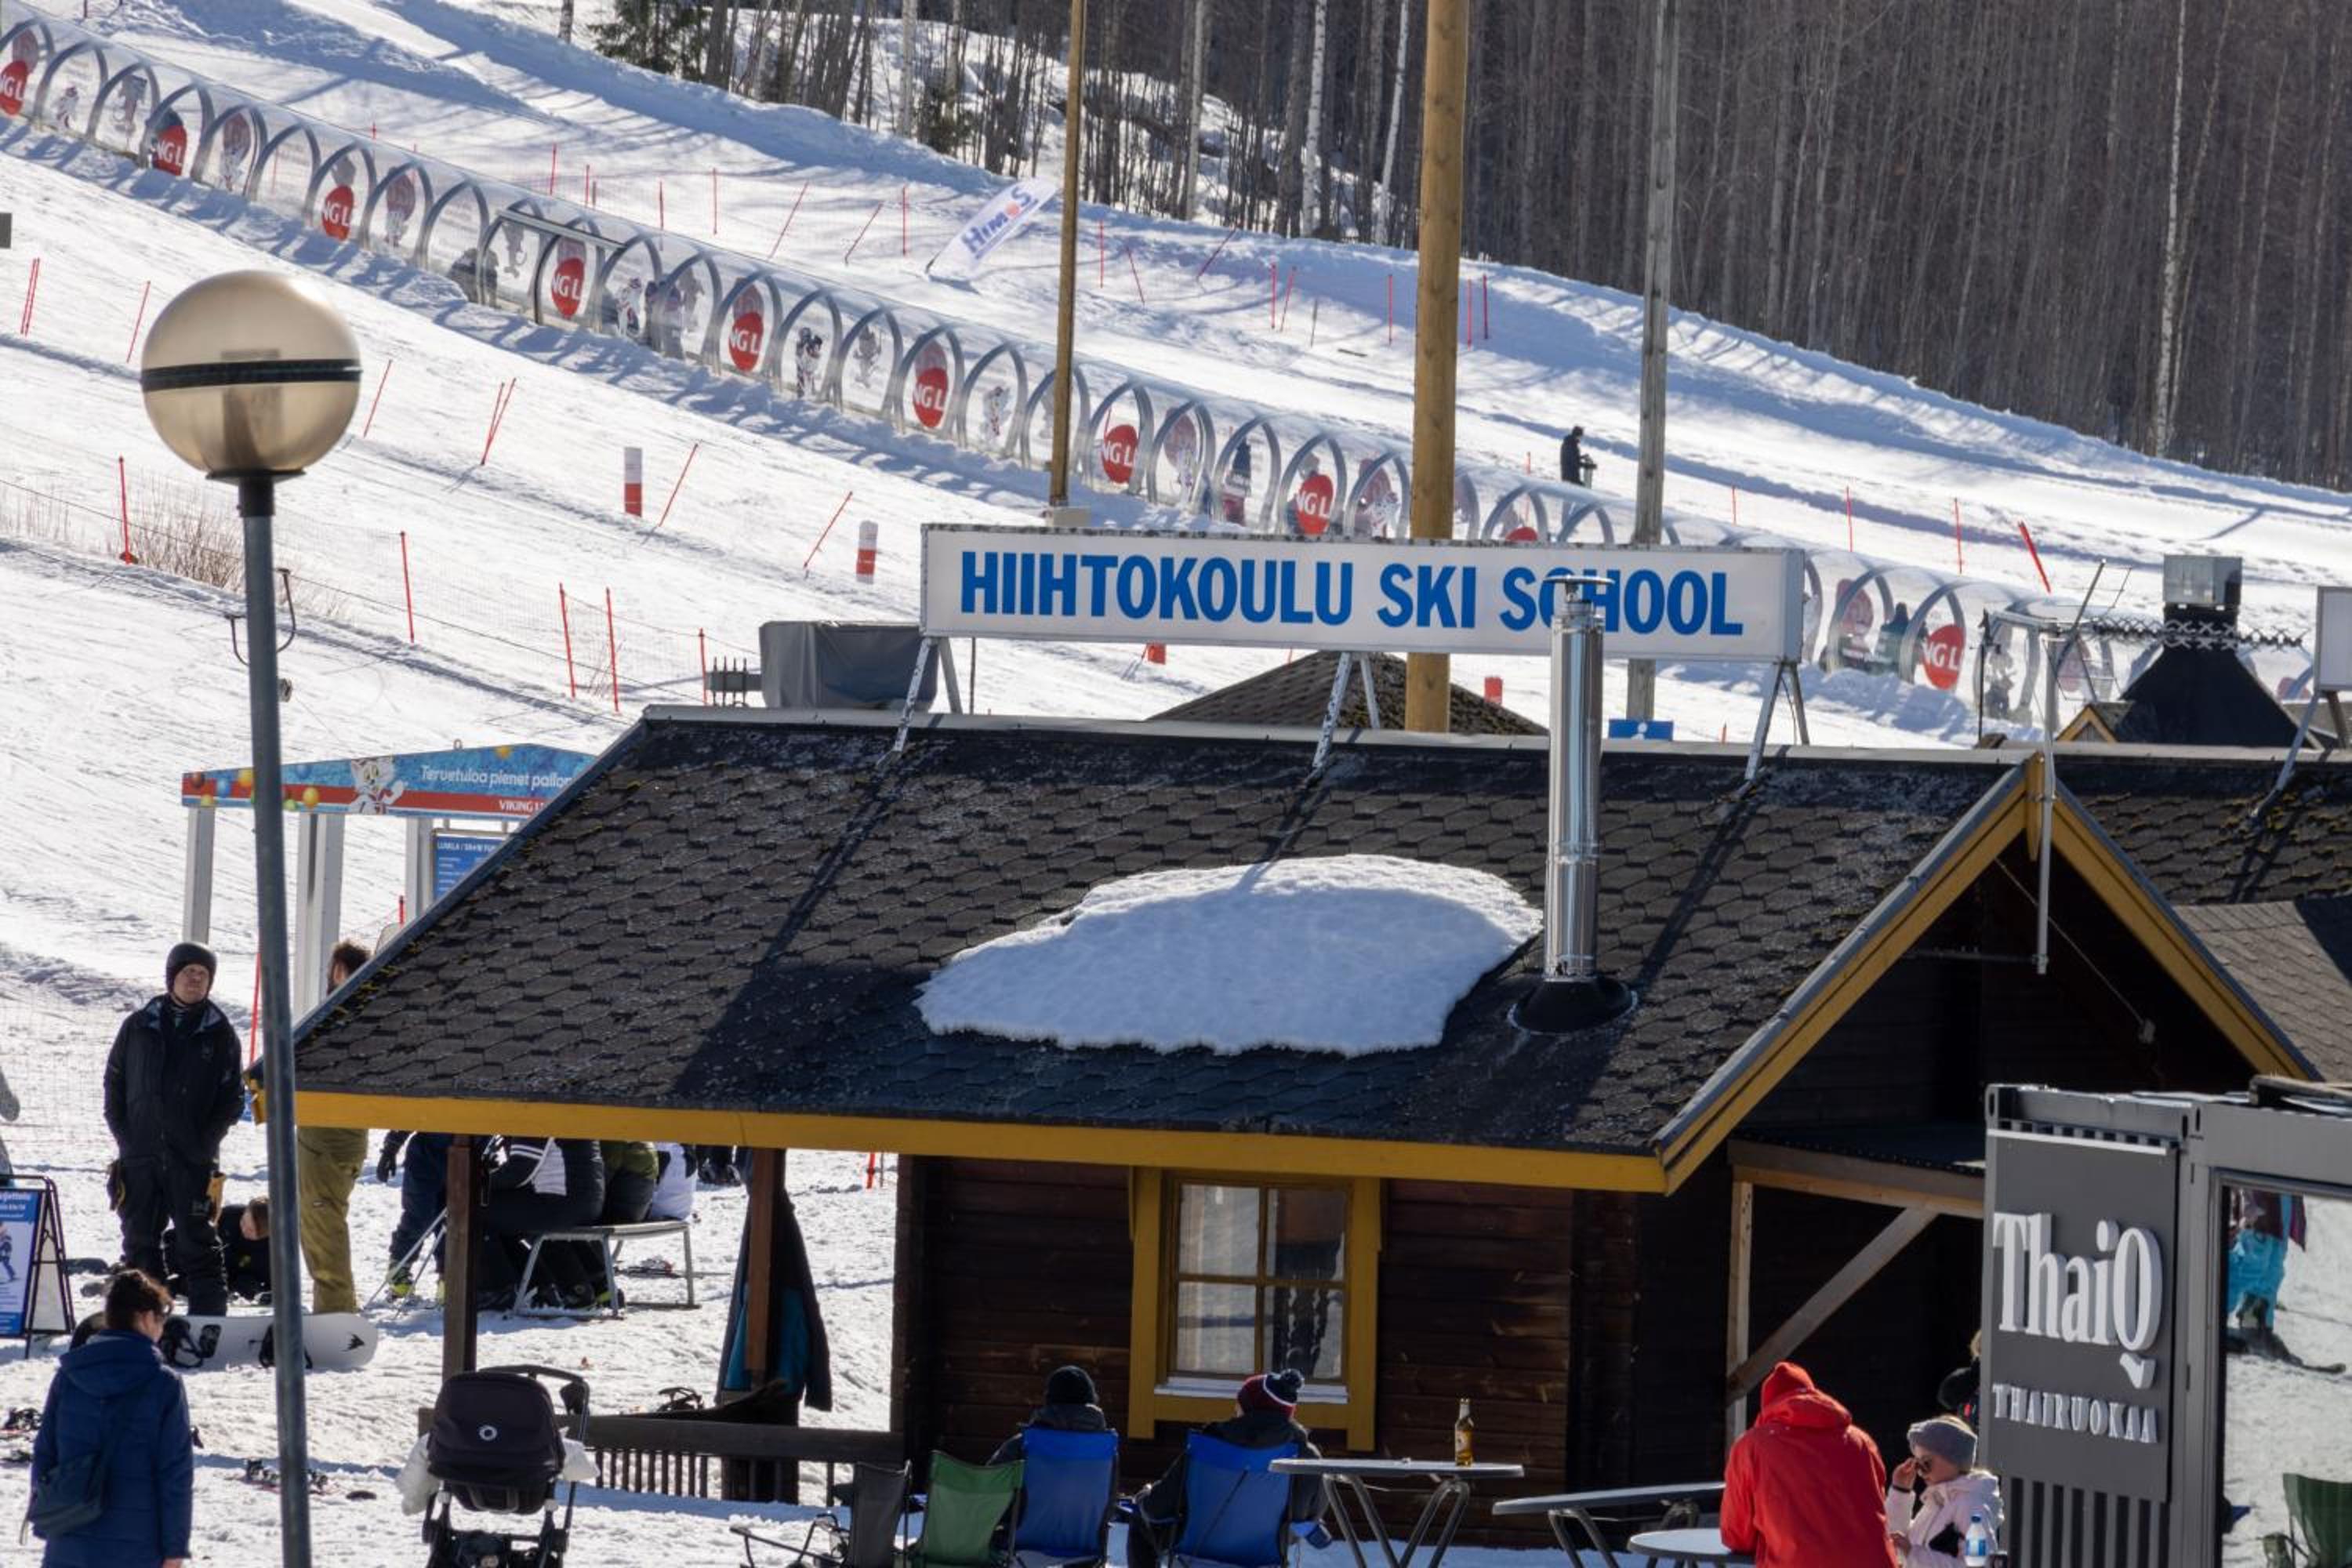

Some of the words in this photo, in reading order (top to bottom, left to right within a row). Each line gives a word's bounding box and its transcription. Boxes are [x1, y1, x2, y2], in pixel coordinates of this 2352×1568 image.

[961, 551, 1353, 626] HIIHTOKOULU
[1377, 563, 1477, 629] SKI
[1499, 566, 1744, 636] SCHOOL
[499, 799, 533, 813] VIKING
[1992, 1212, 2163, 1389] ThaiQ
[1992, 1384, 2158, 1444] THAIRUOKAA
